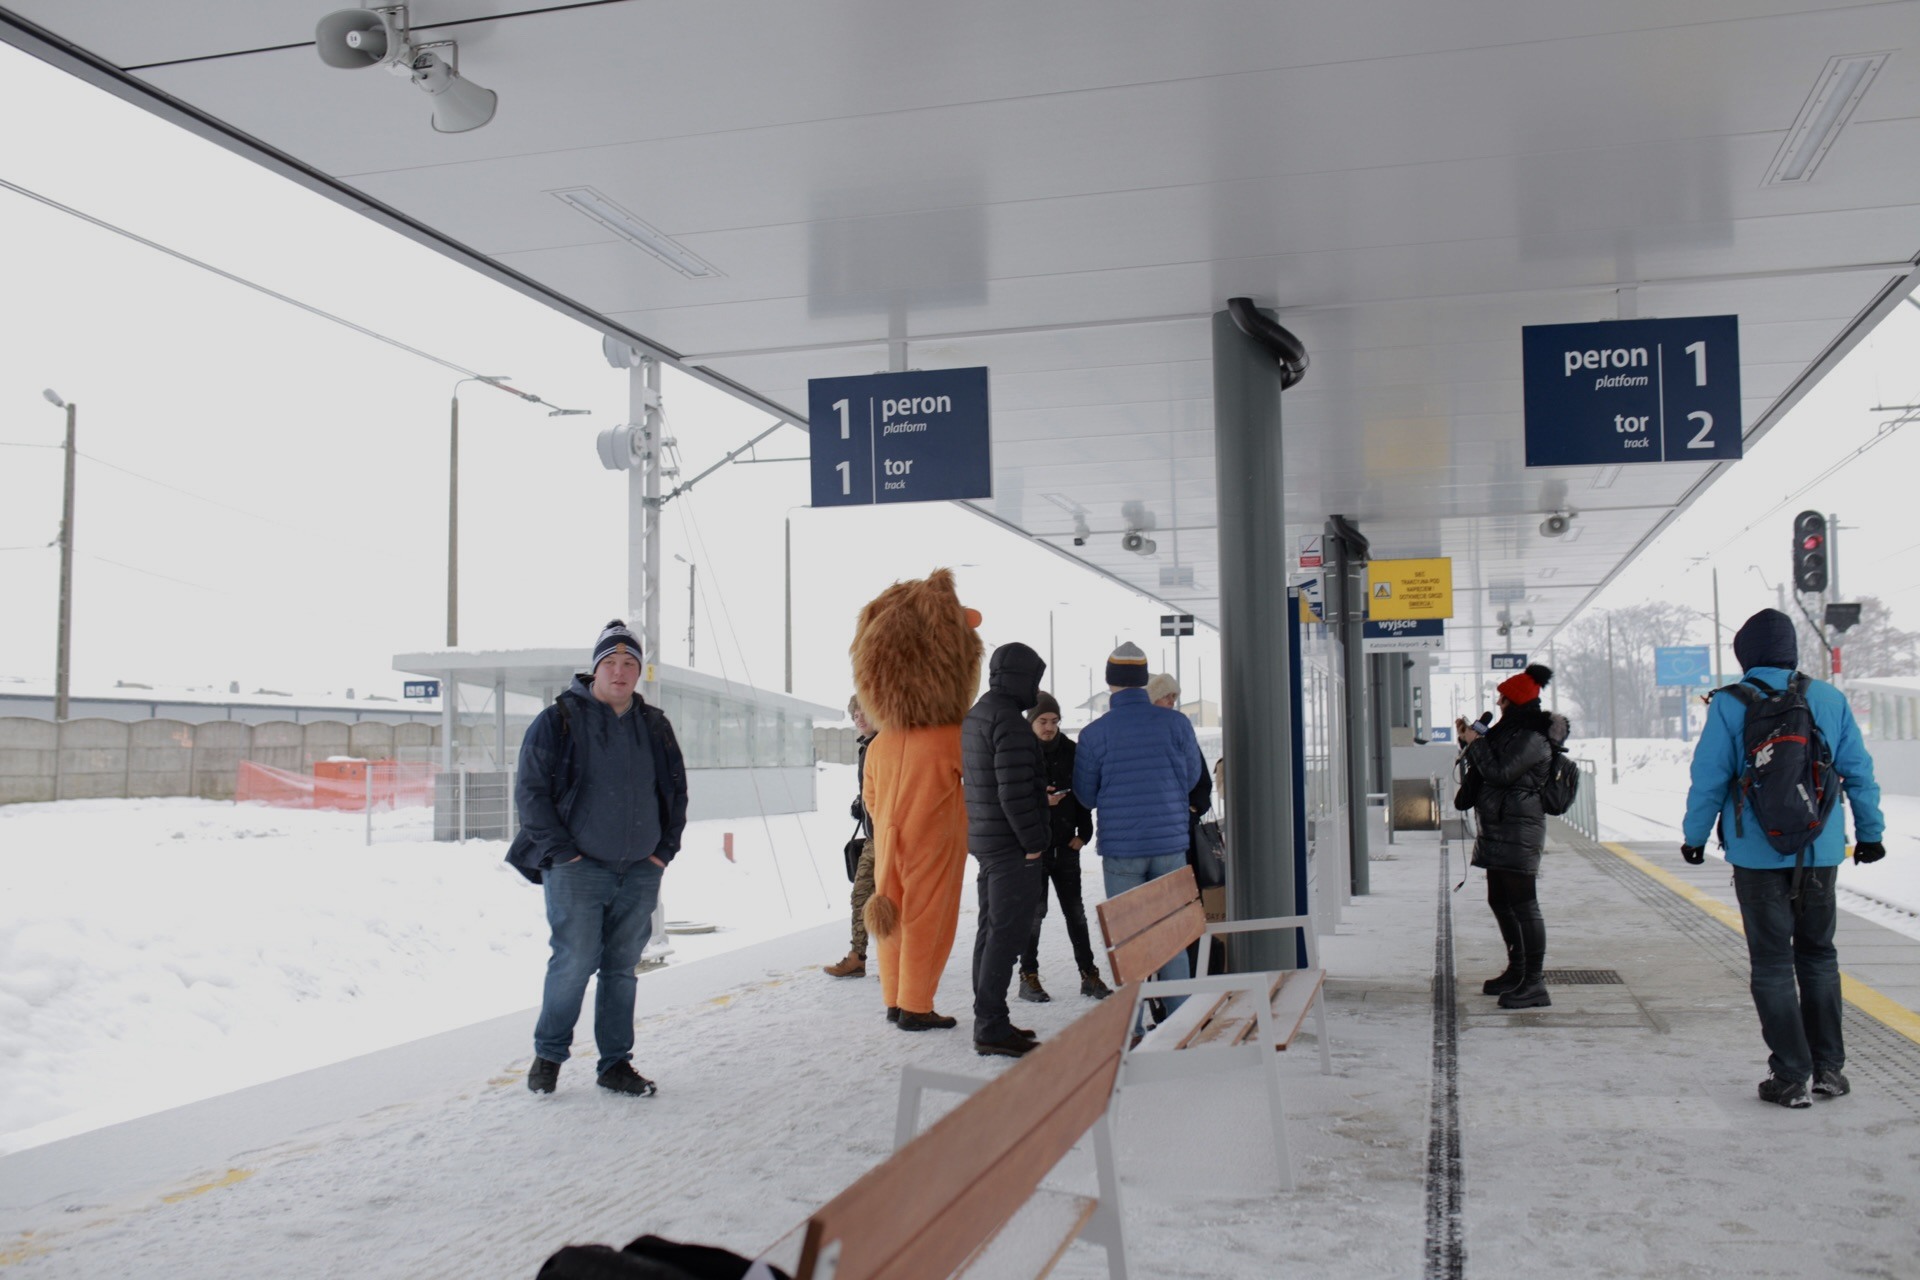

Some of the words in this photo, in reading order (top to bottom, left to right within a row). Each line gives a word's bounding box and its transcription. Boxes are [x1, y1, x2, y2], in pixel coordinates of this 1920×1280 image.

[1564, 347, 1648, 377] peron
[1685, 341, 1707, 387] 1
[1595, 374, 1648, 390] platform
[832, 398, 851, 439] 1
[882, 395, 951, 422] peron
[883, 421, 927, 436] platform
[1614, 413, 1650, 433] tor
[1686, 410, 1715, 449] 2
[1624, 437, 1650, 449] track
[835, 460, 851, 495] 1
[884, 458, 913, 475] tor
[885, 480, 906, 490] track
[1755, 743, 1774, 768] 4F
